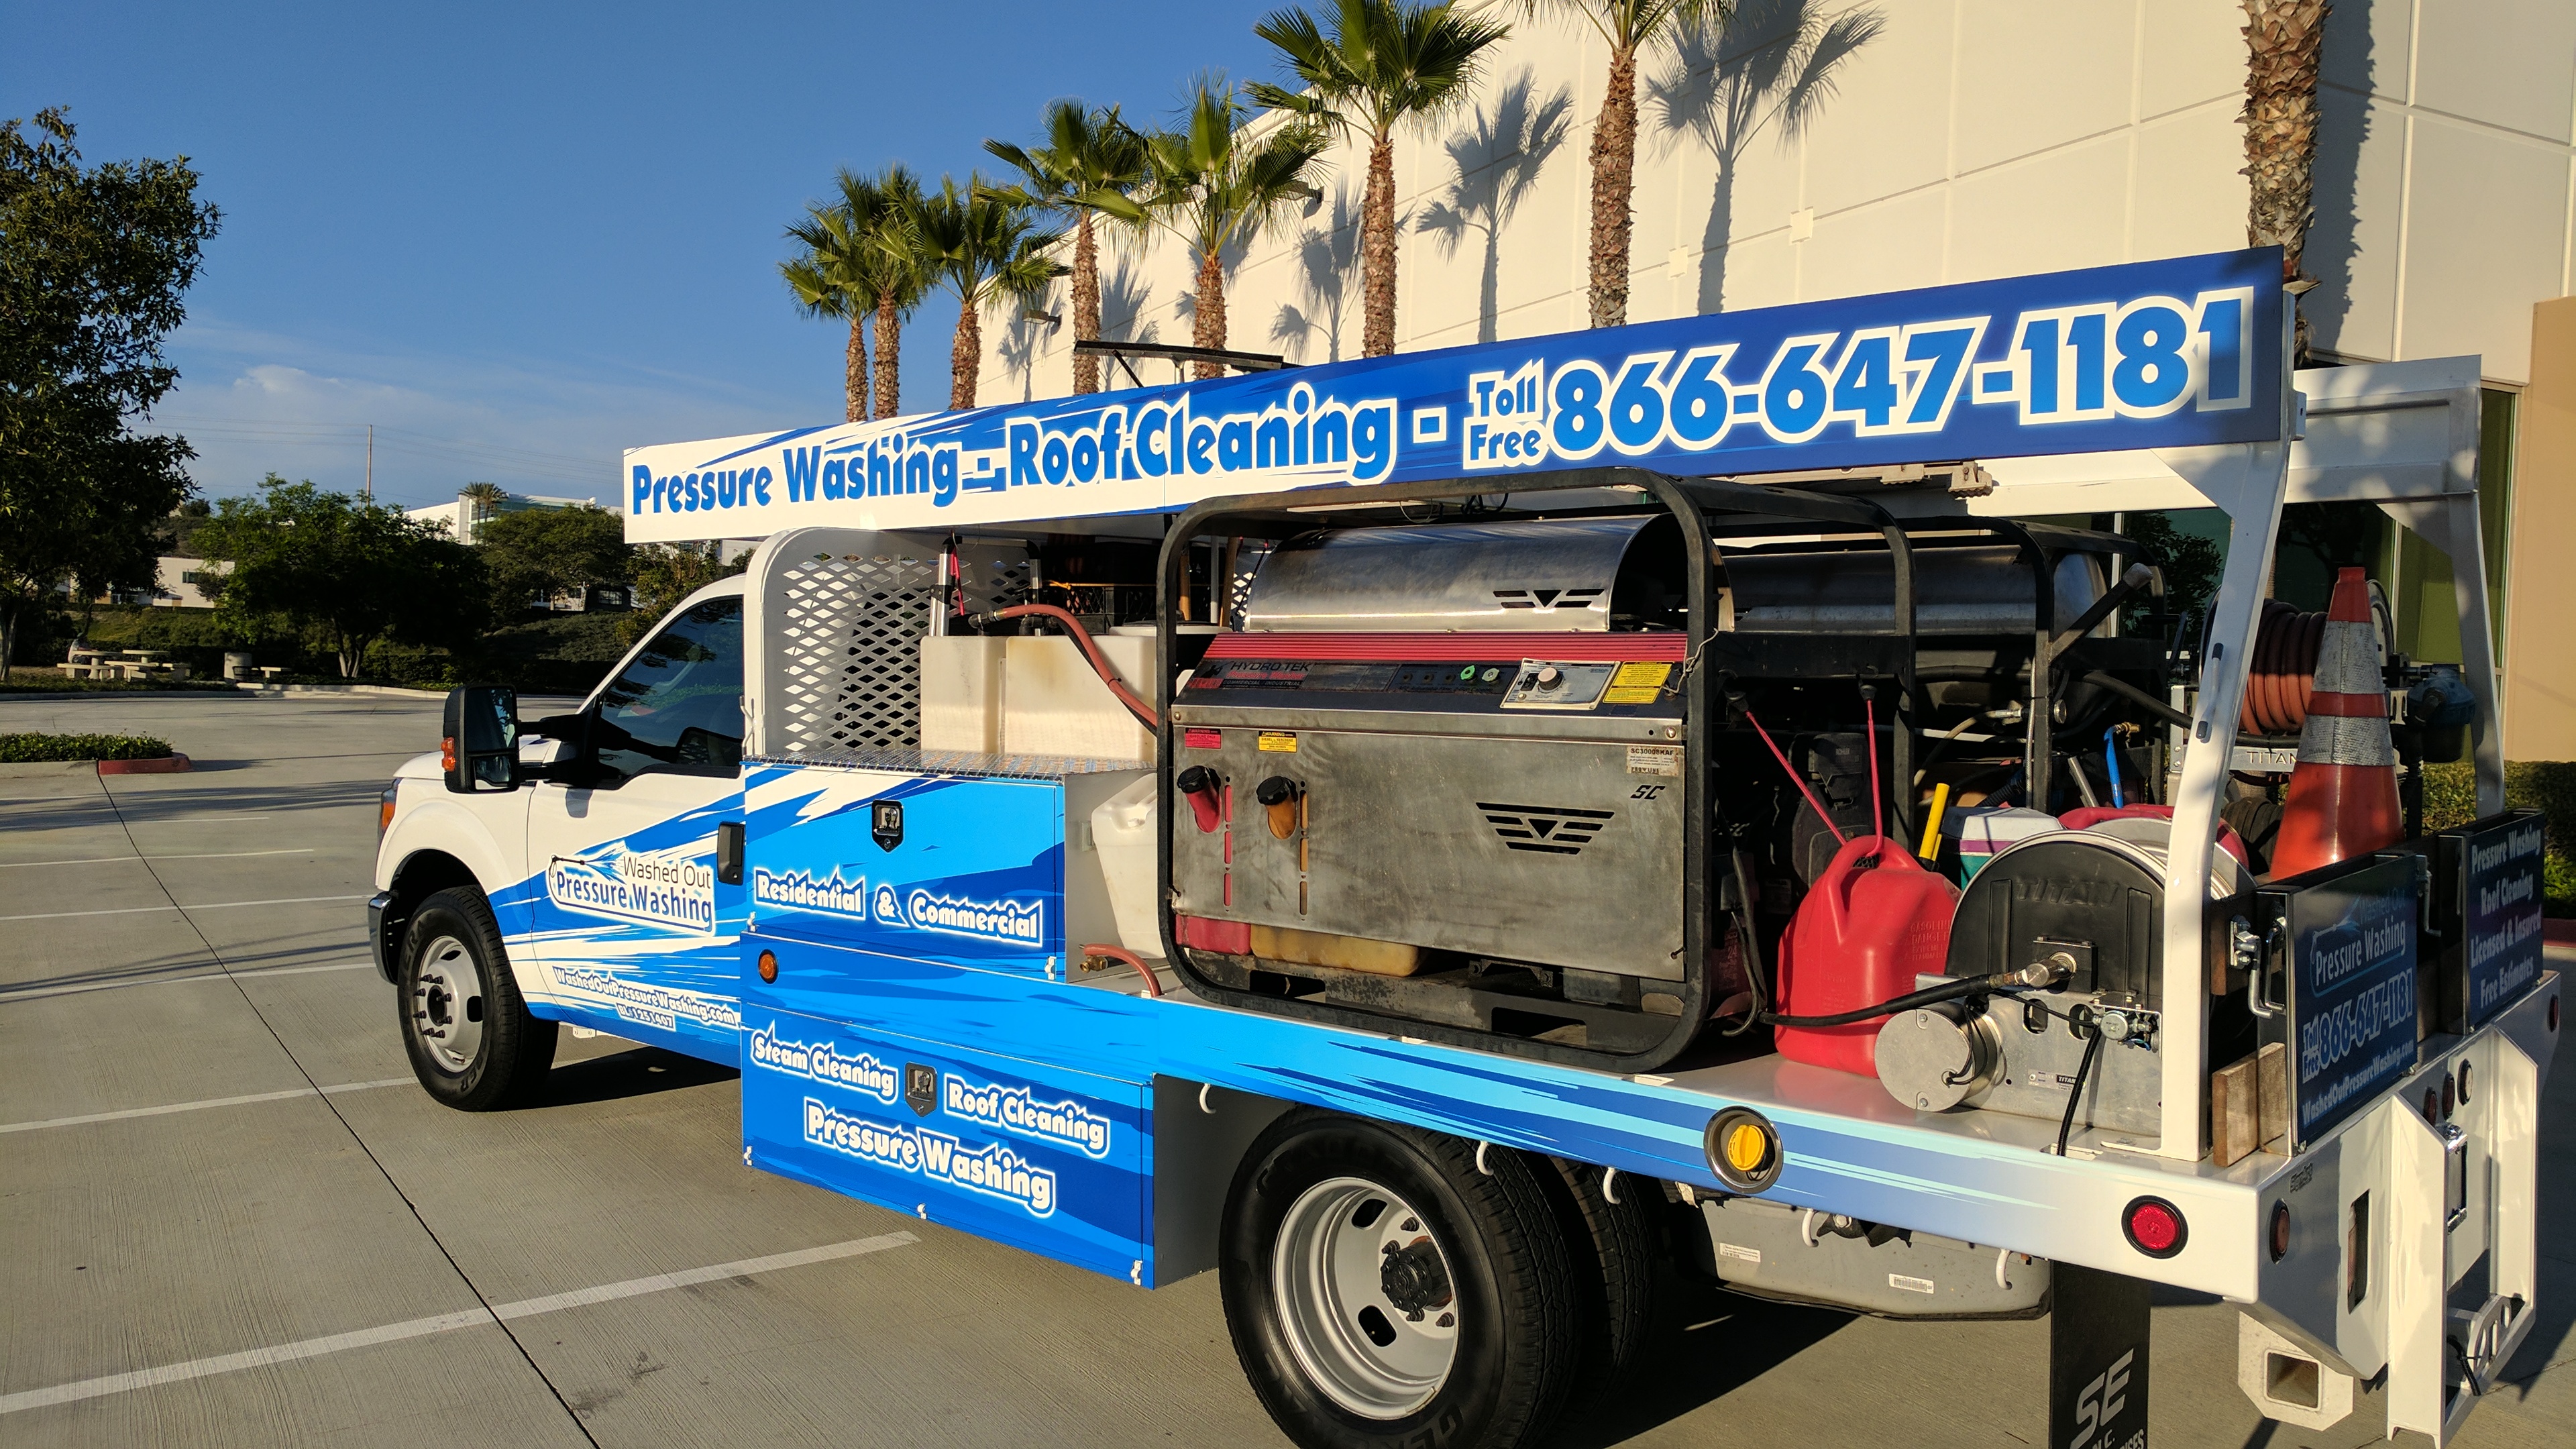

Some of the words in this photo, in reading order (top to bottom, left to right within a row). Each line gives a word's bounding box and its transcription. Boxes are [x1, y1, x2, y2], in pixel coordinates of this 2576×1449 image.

[1476, 374, 1538, 417] Toll
[1553, 289, 2243, 451] 866-647-1181
[633, 464, 772, 515] Pressure
[782, 433, 957, 507] Washing
[1010, 411, 1122, 486] Roof
[1137, 385, 1391, 478] Cleaning
[1470, 423, 1541, 460] Free
[1630, 785, 1666, 800] SC
[623, 856, 678, 883] Washed
[684, 865, 710, 890] Out
[2472, 841, 2507, 873] Pressure
[2508, 824, 2541, 859] Washing
[557, 871, 627, 908] Pressure
[633, 883, 712, 923] Washing
[758, 872, 861, 912] Residential
[877, 893, 896, 918] &
[914, 896, 1037, 938] Commercial
[2017, 877, 2120, 907] TITAN
[2481, 881, 2500, 917] Roof
[2501, 871, 2534, 904] Cleaning
[2316, 937, 2361, 987] Pressure
[2365, 916, 2406, 969] Washing
[2471, 930, 2506, 969] Licensed
[2515, 904, 2542, 943] Insured
[553, 967, 737, 1025] WashedOutPressureWashing.com
[2481, 976, 2498, 1008] Free
[2500, 956, 2534, 998] Estimates
[2304, 1016, 2318, 1049] Toll
[2319, 969, 2414, 1069] 866-647-1181
[755, 1032, 808, 1071] Steam
[812, 1051, 895, 1097] Cleaning
[2302, 1039, 2414, 1126] WashedOutPressureWashing.com
[2303, 1049, 2320, 1082] Free
[949, 1083, 1000, 1118] Roof
[1004, 1098, 1104, 1150] Cleaning
[808, 1106, 920, 1166] Pressure
[922, 1136, 1051, 1210] Washing
[2070, 1348, 2134, 1449] SE
